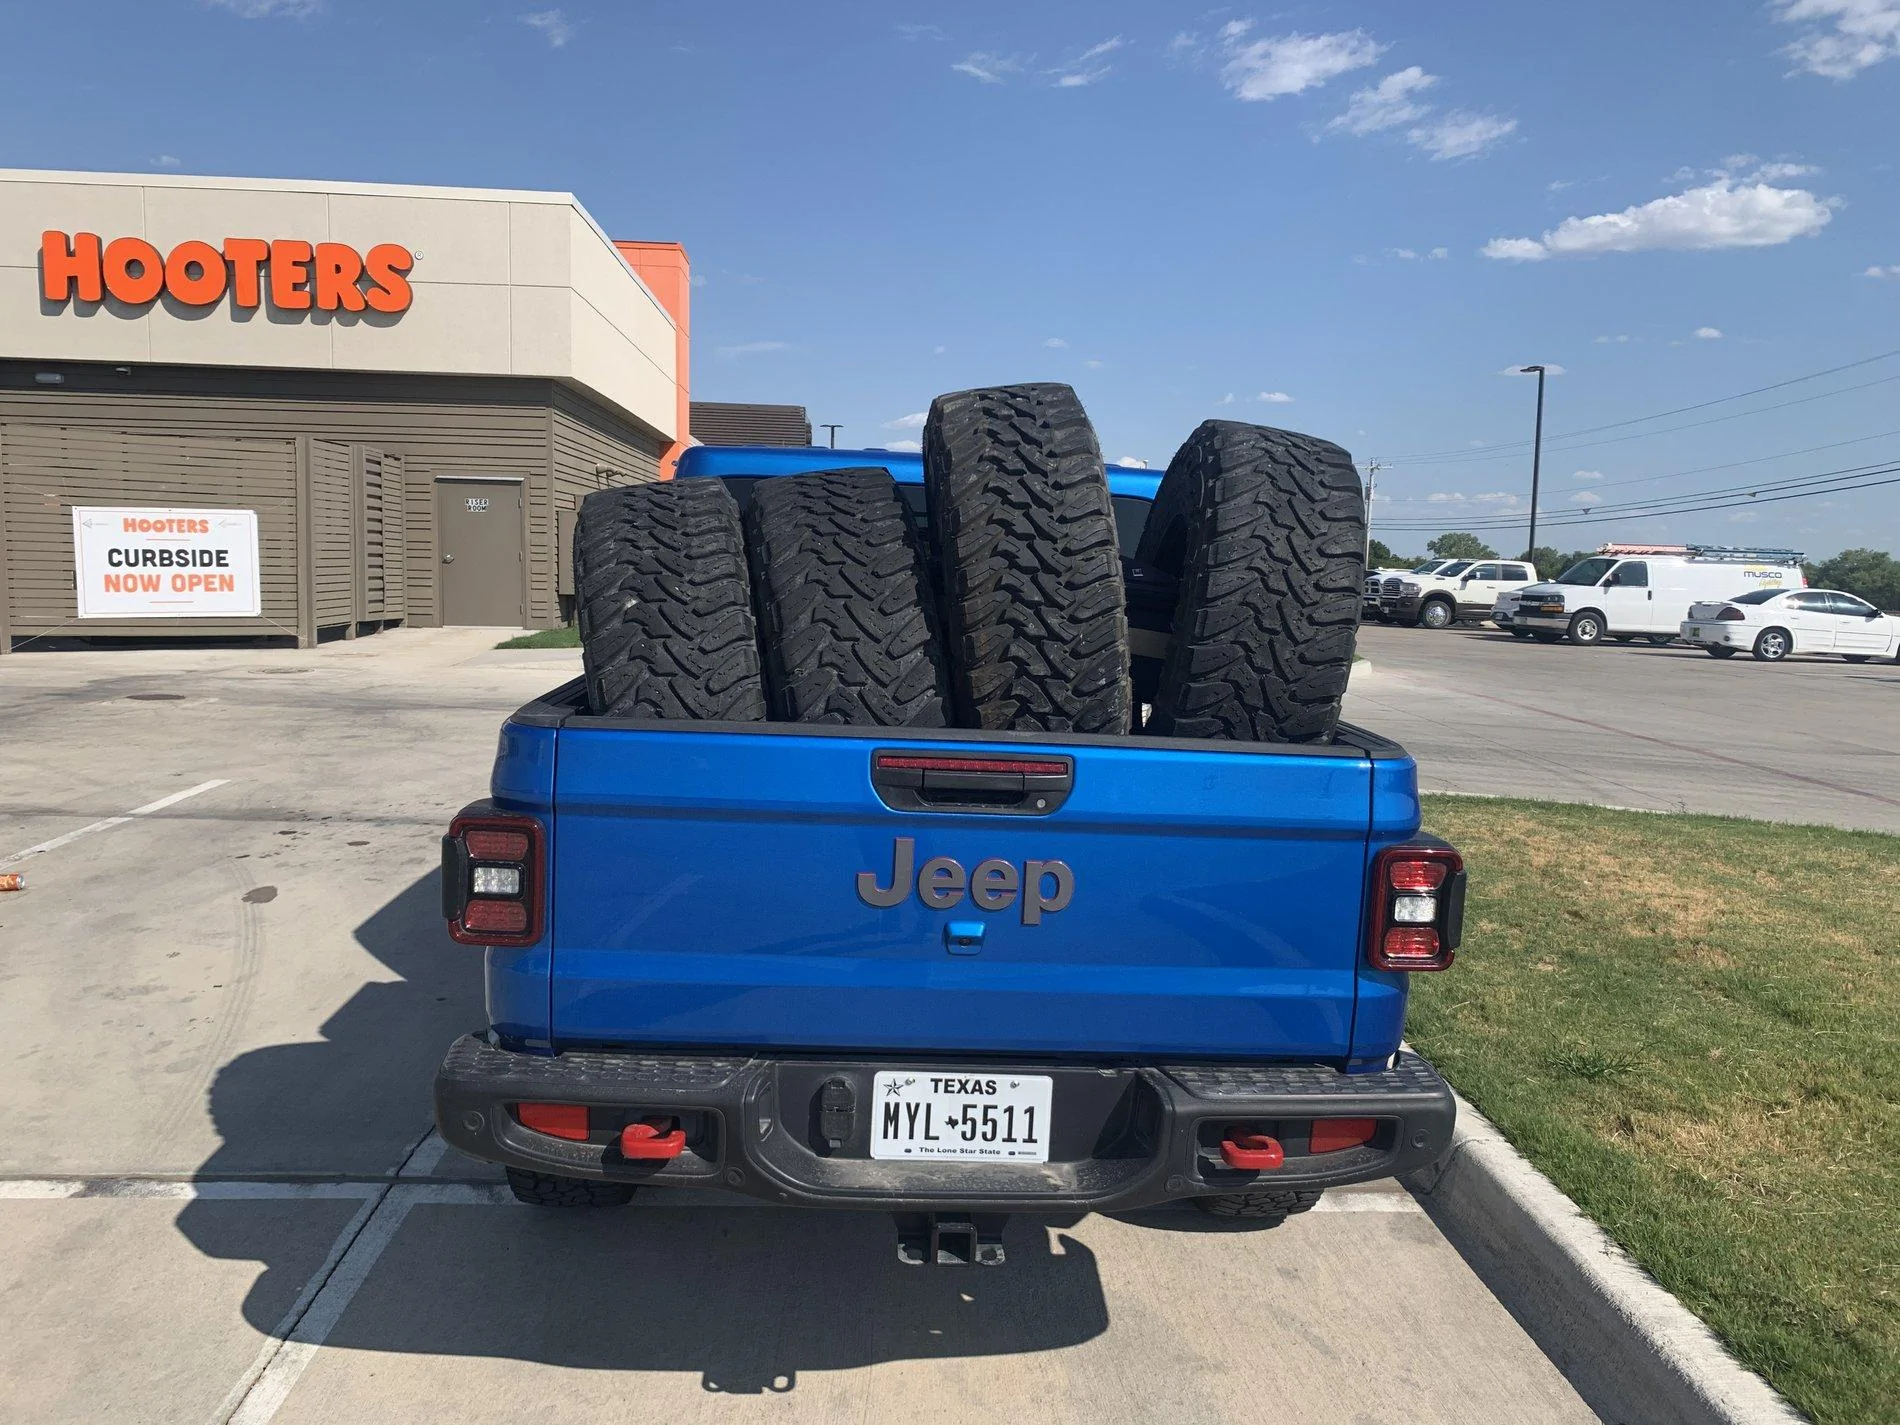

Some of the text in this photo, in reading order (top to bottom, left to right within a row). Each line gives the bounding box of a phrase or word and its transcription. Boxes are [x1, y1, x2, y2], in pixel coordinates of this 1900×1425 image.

[42, 230, 413, 313] HOOTERS
[123, 518, 209, 533] HOOTERS
[108, 548, 229, 567] CURBSIDE
[104, 573, 235, 593] NOW OPEN
[856, 836, 1075, 927] Jeep
[930, 1078, 997, 1095] TEXAS
[882, 1101, 1038, 1144] MYL 5511
